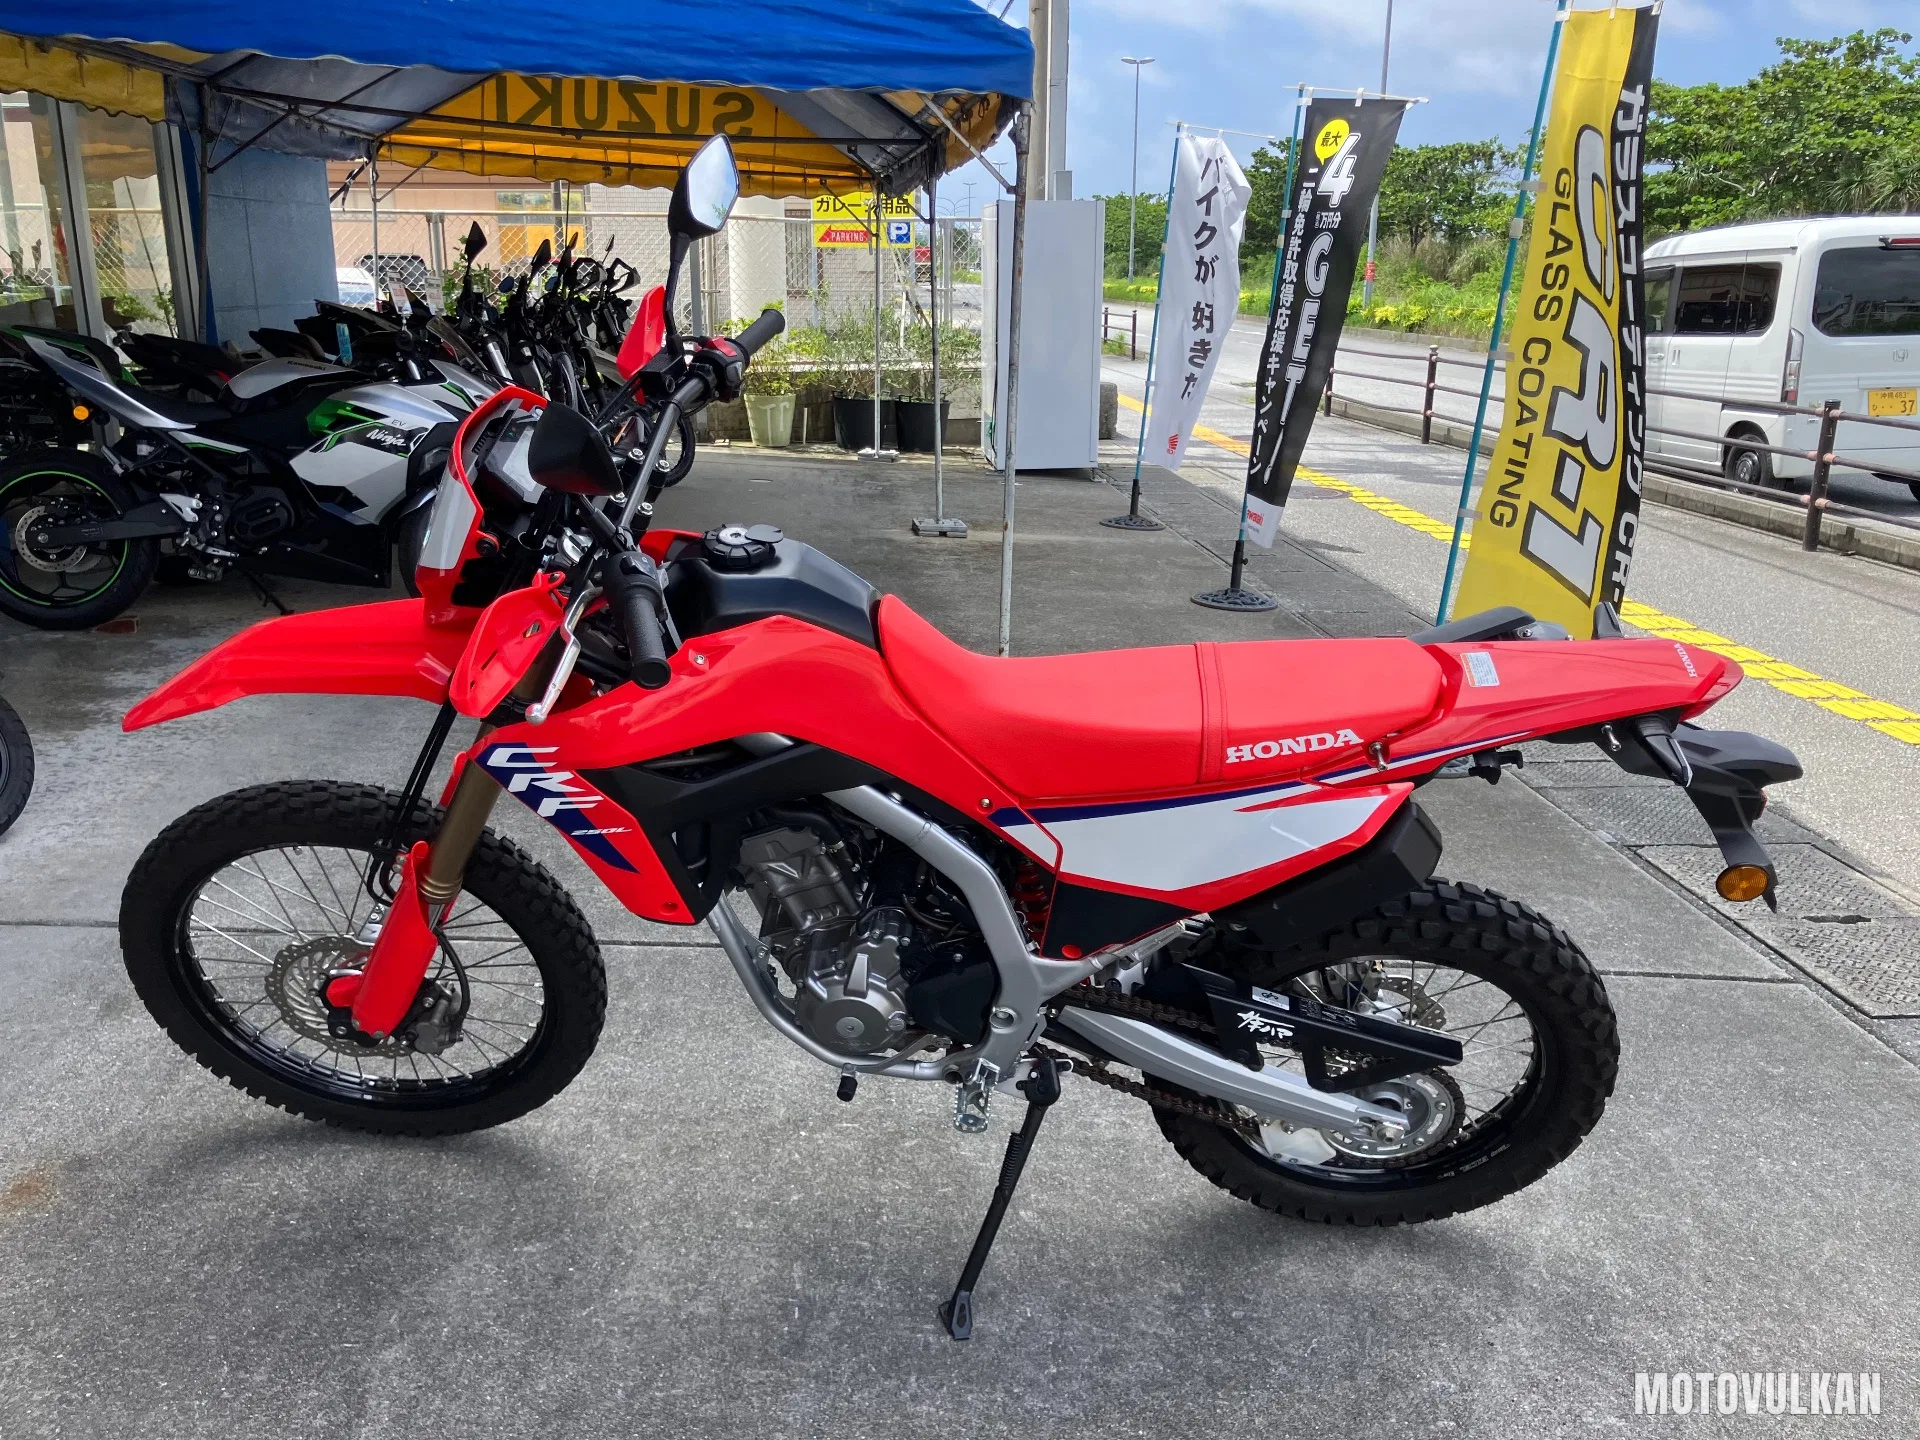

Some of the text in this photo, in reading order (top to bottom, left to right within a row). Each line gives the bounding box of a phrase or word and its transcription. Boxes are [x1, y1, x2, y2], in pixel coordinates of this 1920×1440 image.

[1321, 131, 1342, 147] 最大
[831, 231, 864, 242] PARKING
[1250, 167, 1318, 475] 二輪免許取得応援キャンペーン
[1489, 167, 1573, 528] GLASS COATING
[1519, 124, 1617, 609] CR-1
[366, 429, 407, 447] Ninja
[391, 419, 406, 427] EV
[1673, 642, 1699, 678] HONDA
[1225, 728, 1365, 763] HONDA
[486, 746, 604, 818] CRF
[570, 826, 633, 836] 250L
